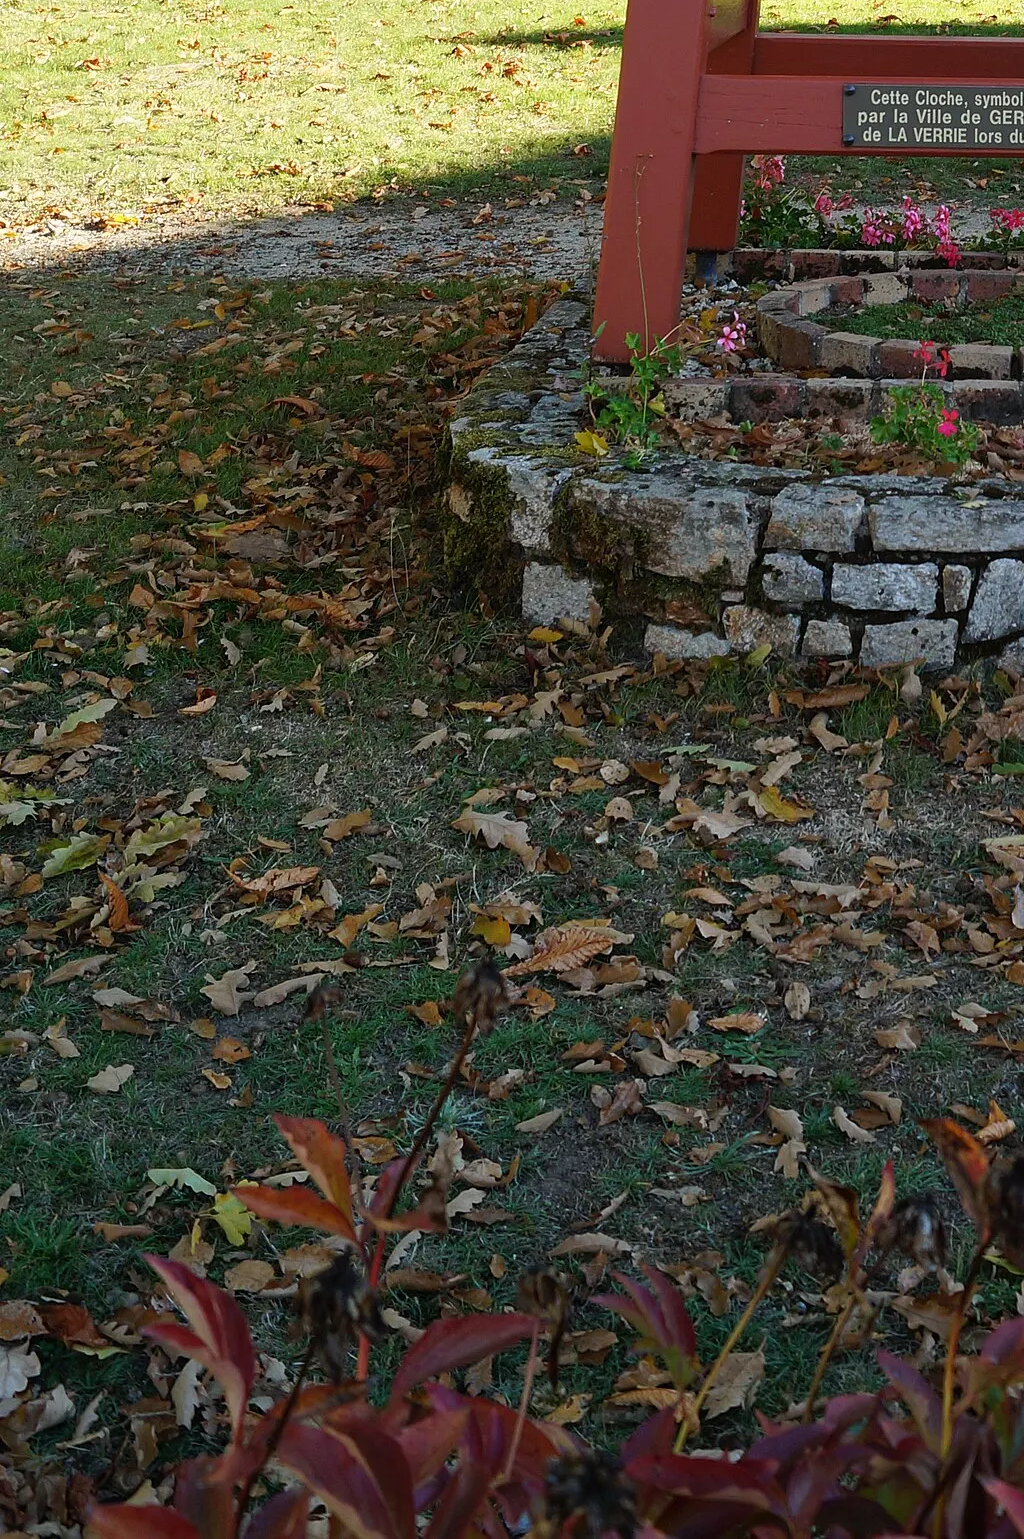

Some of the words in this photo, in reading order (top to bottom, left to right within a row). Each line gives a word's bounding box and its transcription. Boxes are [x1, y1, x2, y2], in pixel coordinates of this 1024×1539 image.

[871, 89, 909, 105] Cette
[915, 90, 968, 108] Cloche,
[858, 110, 885, 125] par
[894, 109, 908, 123] la
[916, 109, 952, 124] Ville
[961, 110, 981, 124] de
[863, 127, 881, 142] de
[889, 128, 907, 142] LA
[914, 128, 967, 143] VERRIE
[974, 129, 1002, 143] lors
